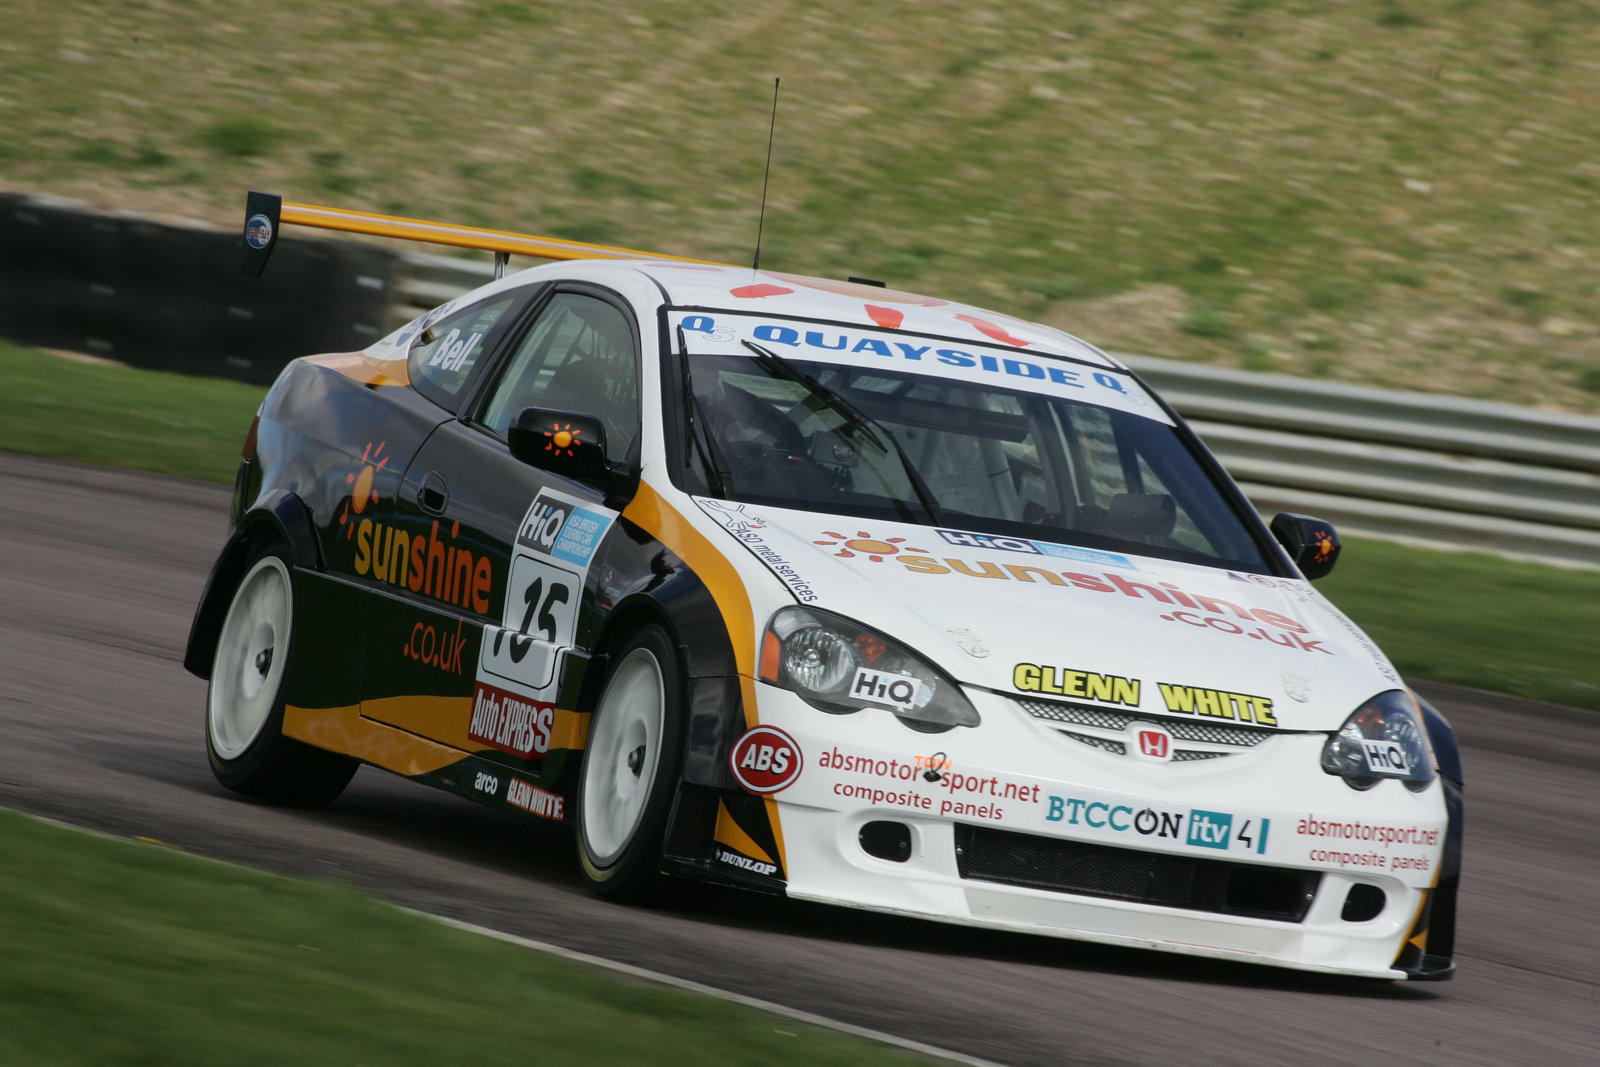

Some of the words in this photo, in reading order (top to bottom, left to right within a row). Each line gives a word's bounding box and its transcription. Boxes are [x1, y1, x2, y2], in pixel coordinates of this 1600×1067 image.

[428, 323, 483, 372] Bell
[753, 325, 1085, 388] QUAYSIDE
[521, 502, 565, 549] HiQ
[940, 531, 1038, 554] HiQ
[354, 519, 492, 615] sunshine
[731, 529, 763, 543] ASD
[752, 545, 790, 566] metal
[775, 565, 818, 602] services
[896, 556, 1310, 633] sunshine
[494, 577, 569, 664] 15
[1160, 611, 1335, 655] .co.uk
[403, 618, 467, 675] .co.uk
[855, 670, 915, 704] HiQ
[1013, 663, 1140, 707] GLENN
[1157, 682, 1277, 726] WHITE
[470, 688, 500, 740] Auto
[495, 697, 554, 753] EXPRESS
[740, 744, 792, 775] ABS
[914, 756, 953, 769] TOW
[1365, 744, 1406, 770] HiQ
[474, 772, 498, 795] arco
[506, 779, 533, 809] GLENN
[529, 788, 565, 819] WHITE
[833, 782, 931, 809] composite
[940, 796, 1003, 820] panels
[1297, 814, 1439, 848] absmotorsport.net
[720, 851, 777, 876] DUNLOP
[1309, 849, 1387, 868] composite
[1391, 855, 1430, 871] panels
